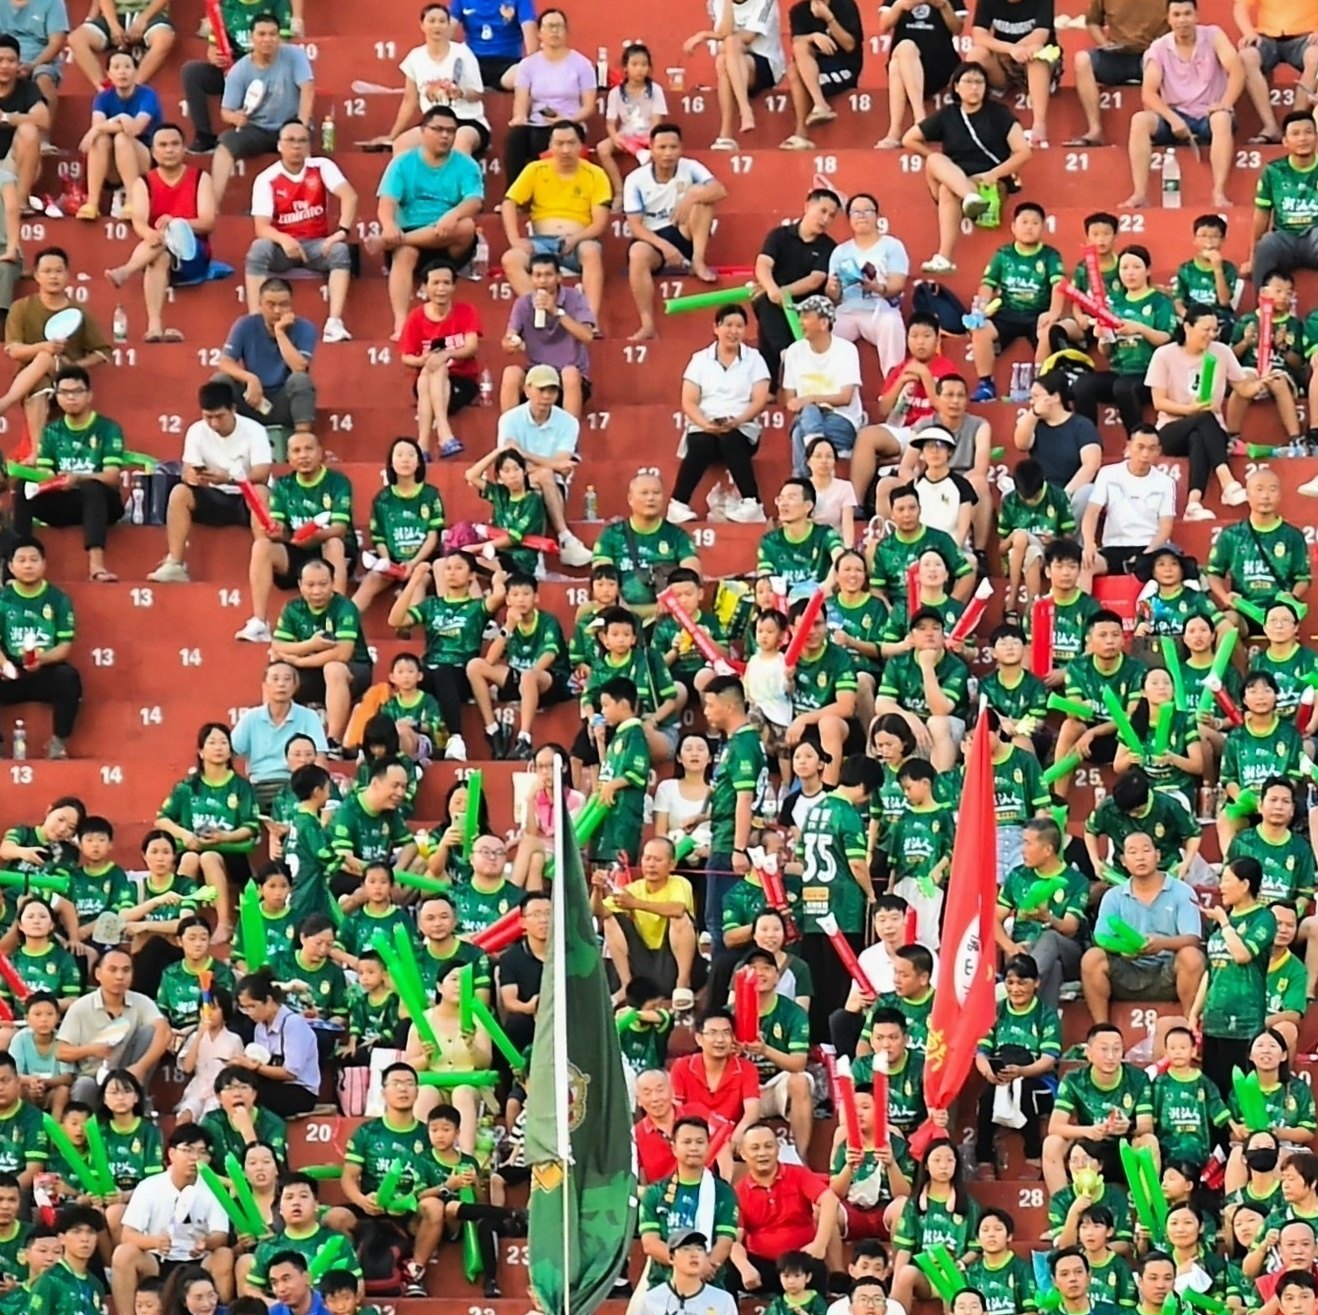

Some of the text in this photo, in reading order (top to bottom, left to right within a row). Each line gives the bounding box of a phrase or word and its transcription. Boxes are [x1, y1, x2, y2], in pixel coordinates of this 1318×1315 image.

[374, 40, 397, 60] 11
[681, 96, 705, 114] 16
[848, 93, 871, 112] 18
[1270, 88, 1295, 106] 23
[899, 153, 923, 173] 19
[1236, 150, 1262, 169] 23
[105, 222, 128, 240] 10
[1118, 213, 1146, 235] 22
[489, 282, 512, 300] 15
[367, 346, 391, 365] 14
[158, 414, 183, 434] 12
[760, 410, 785, 429] 19
[218, 588, 242, 607] 14
[91, 647, 115, 667] 13
[99, 765, 124, 785] 14
[305, 1123, 333, 1143] 20
